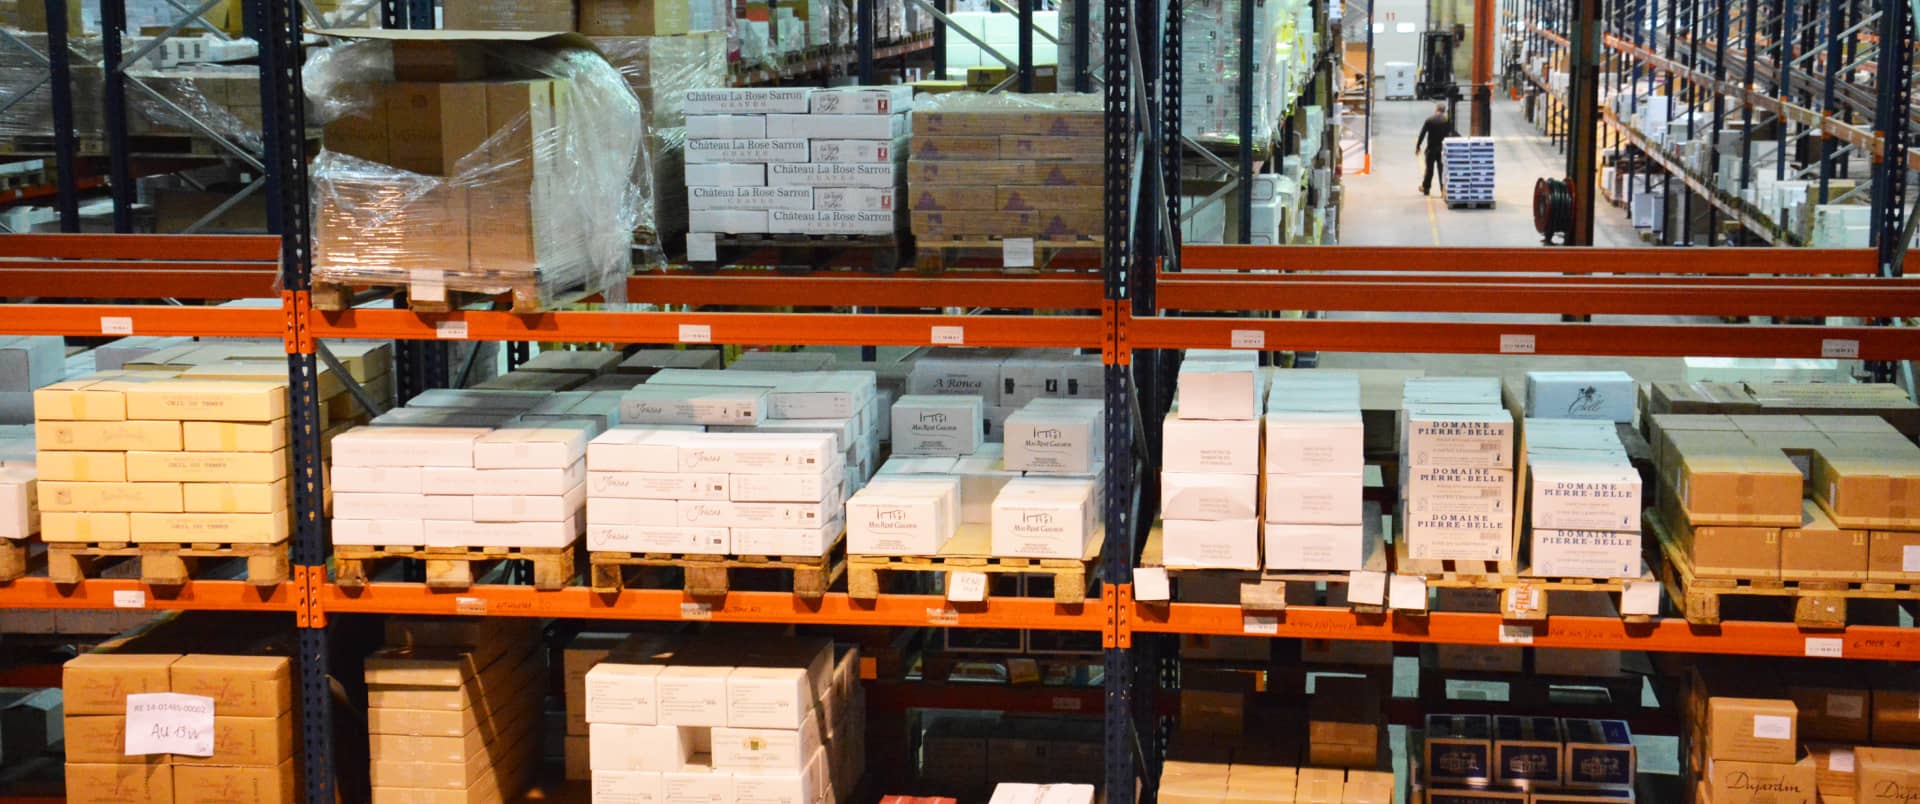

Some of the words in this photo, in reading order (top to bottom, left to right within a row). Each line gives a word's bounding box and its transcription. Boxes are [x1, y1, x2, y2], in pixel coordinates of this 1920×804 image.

[730, 91, 742, 101] La
[745, 91, 767, 101] Rose
[769, 91, 802, 101] Sarron
[732, 141, 744, 150] La
[748, 141, 769, 150] Rose
[772, 141, 804, 150] Sarron
[817, 165, 830, 175] La
[832, 165, 854, 175] Rose
[857, 165, 891, 175] Sarron
[737, 188, 749, 198] La
[752, 188, 774, 198] Rose
[777, 188, 810, 198] Sarron
[817, 211, 830, 221] La
[832, 211, 855, 221] Rose
[857, 211, 891, 221] Sarron
[1432, 421, 1490, 429] DOMAINE
[1418, 428, 1505, 436] PIERRE-BELLE
[1557, 482, 1618, 490] DOMAINE
[1544, 489, 1633, 498] PIERRE-BELLE
[1417, 521, 1504, 529] PIERRE-BELLE
[1557, 530, 1617, 538] DOMAINE
[1543, 537, 1632, 546] PIERRE-BELLE
